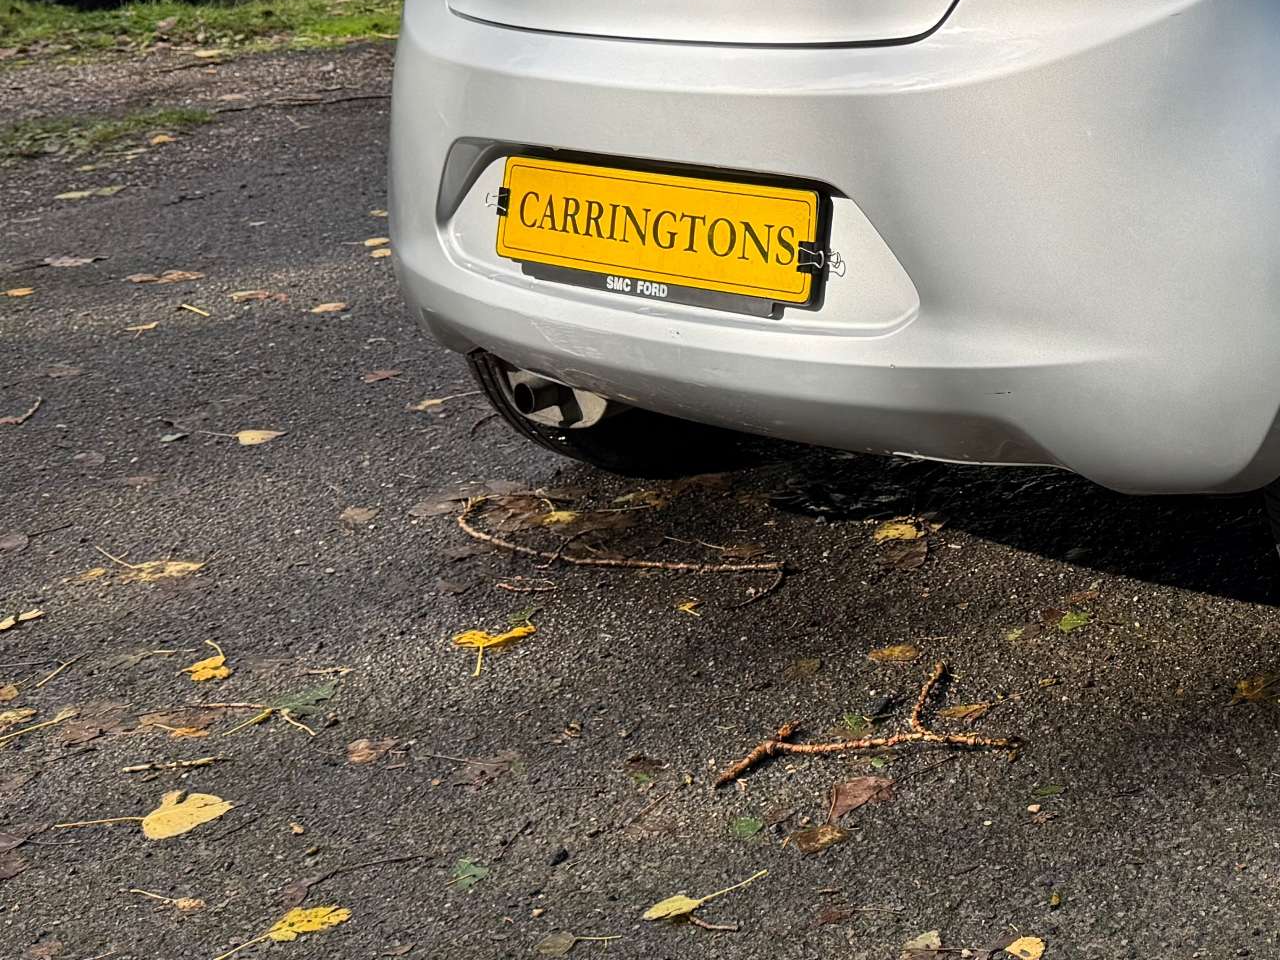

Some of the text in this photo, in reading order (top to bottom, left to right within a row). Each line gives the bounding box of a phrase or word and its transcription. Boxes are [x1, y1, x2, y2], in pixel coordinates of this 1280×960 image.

[519, 191, 796, 266] CARRINGTONS
[606, 275, 668, 298] SMC FORD
